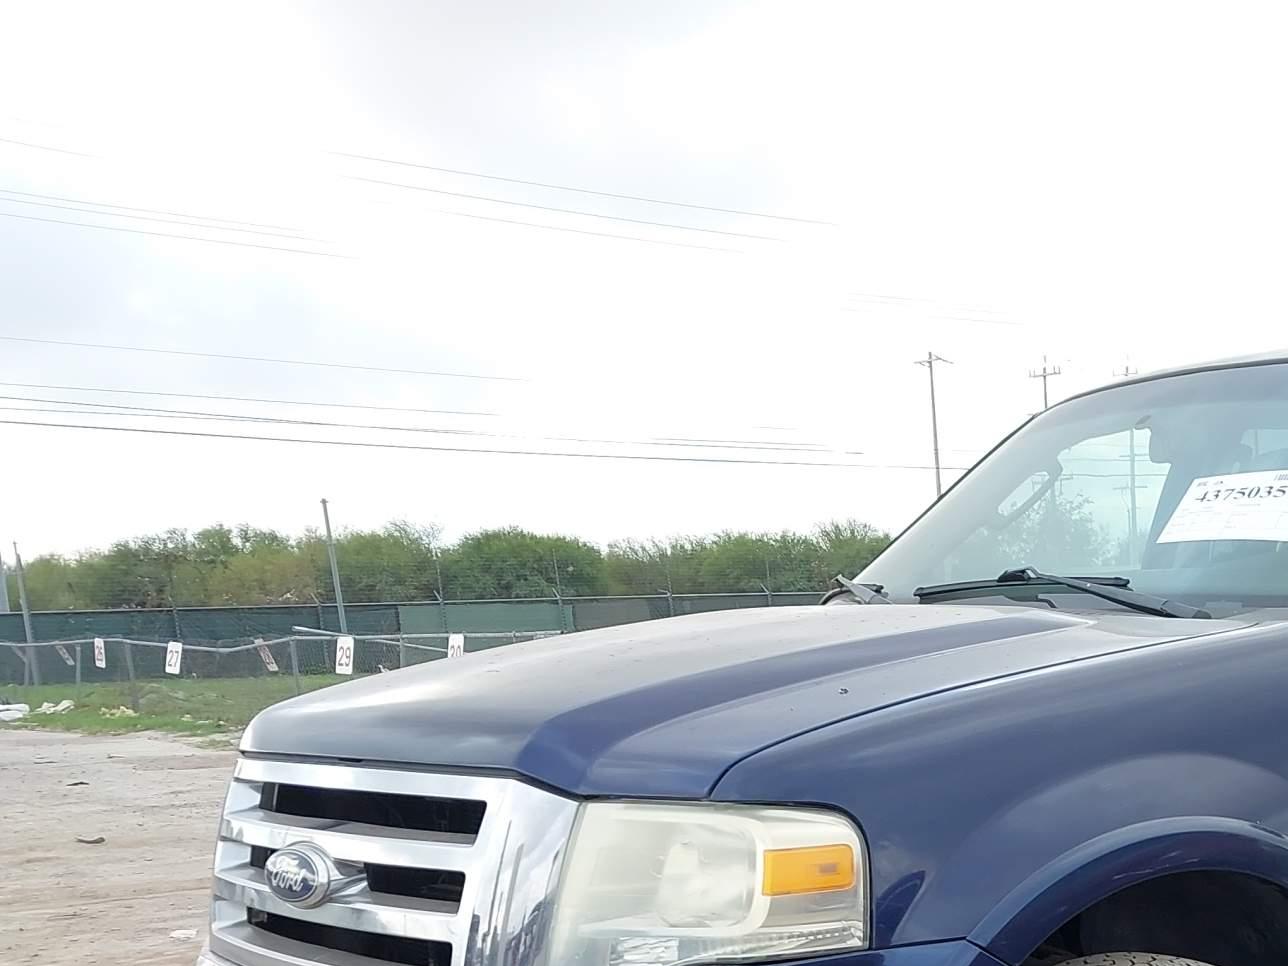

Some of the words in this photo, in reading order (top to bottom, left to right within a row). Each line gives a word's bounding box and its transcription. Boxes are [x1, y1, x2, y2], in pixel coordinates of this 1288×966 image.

[167, 649, 180, 668] 27
[337, 645, 352, 667] 29
[271, 855, 306, 892] Ford
